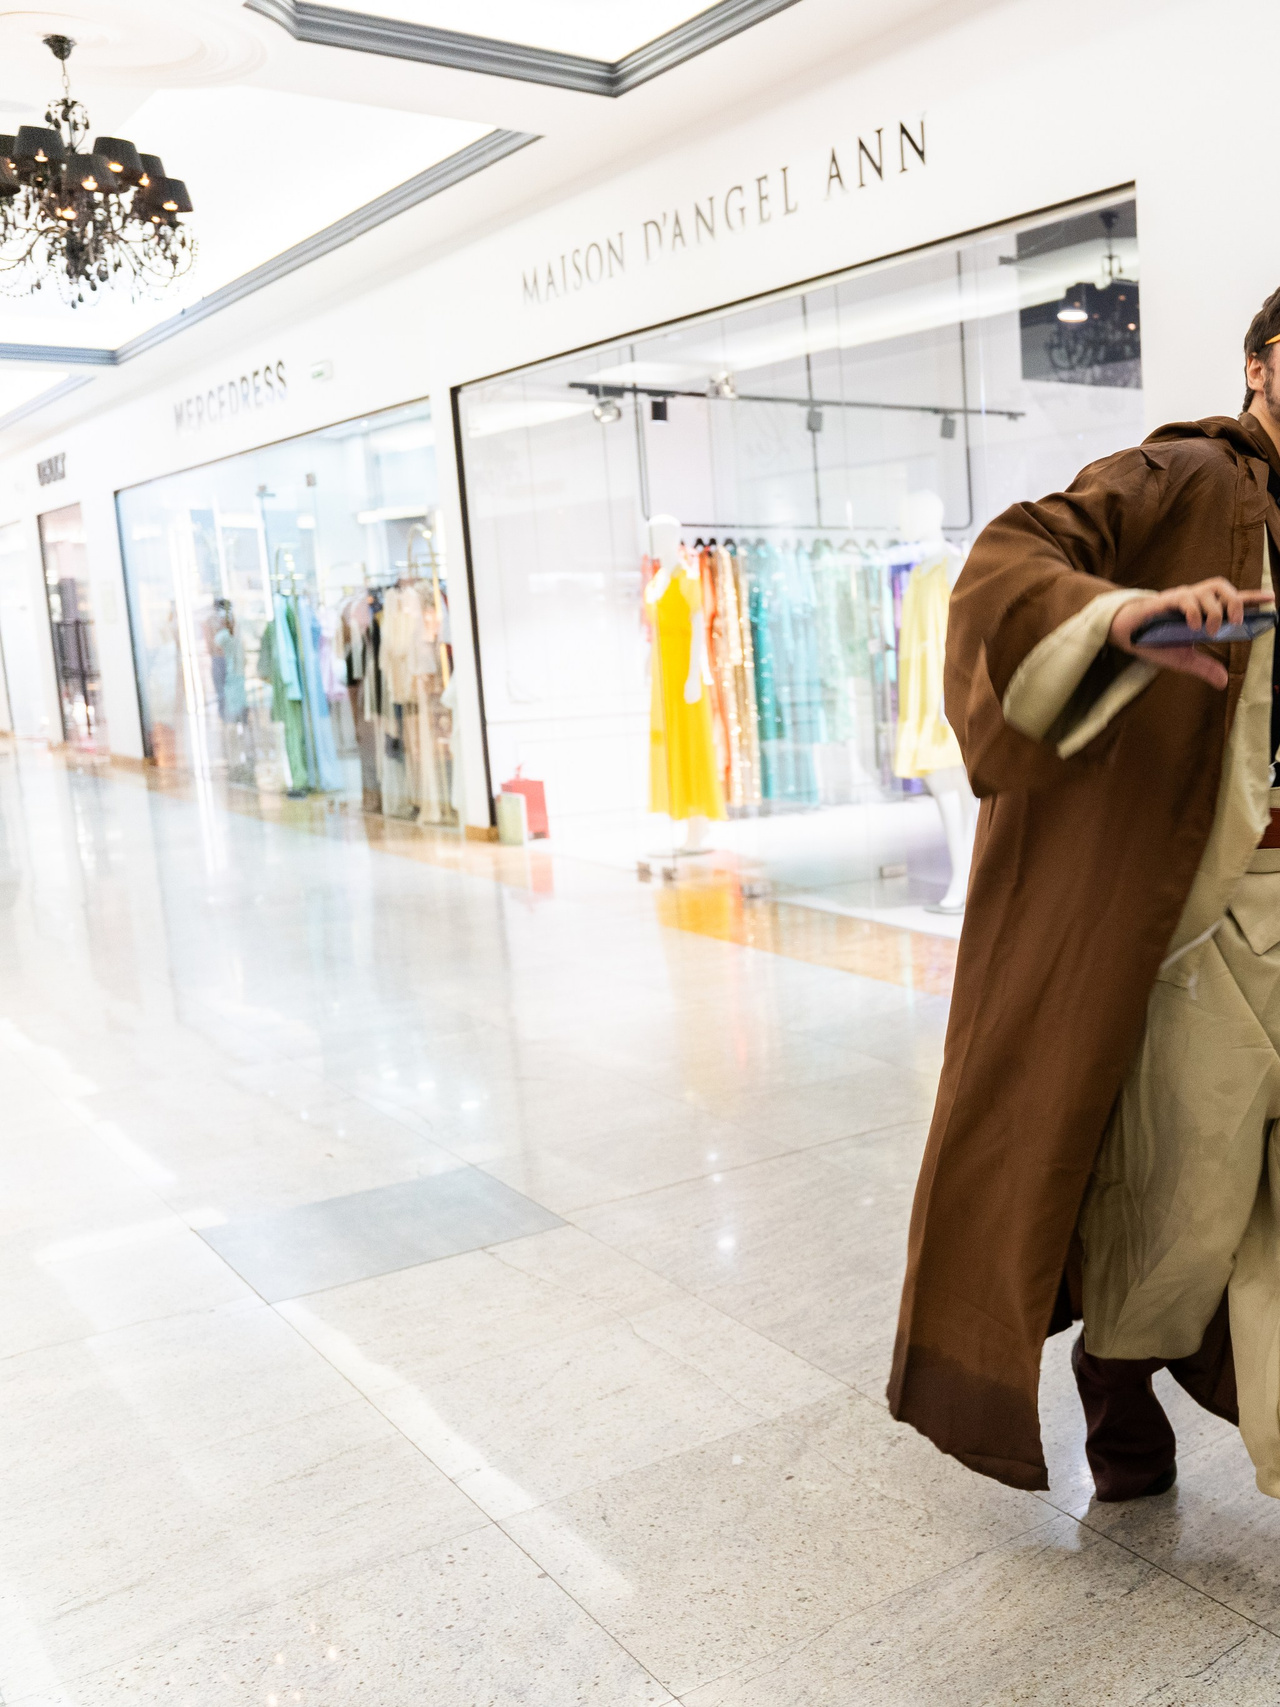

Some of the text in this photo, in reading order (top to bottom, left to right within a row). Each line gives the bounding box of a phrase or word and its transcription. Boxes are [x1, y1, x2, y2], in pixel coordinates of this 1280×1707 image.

[522, 117, 927, 305] MAISON D'ANGEL ANN
